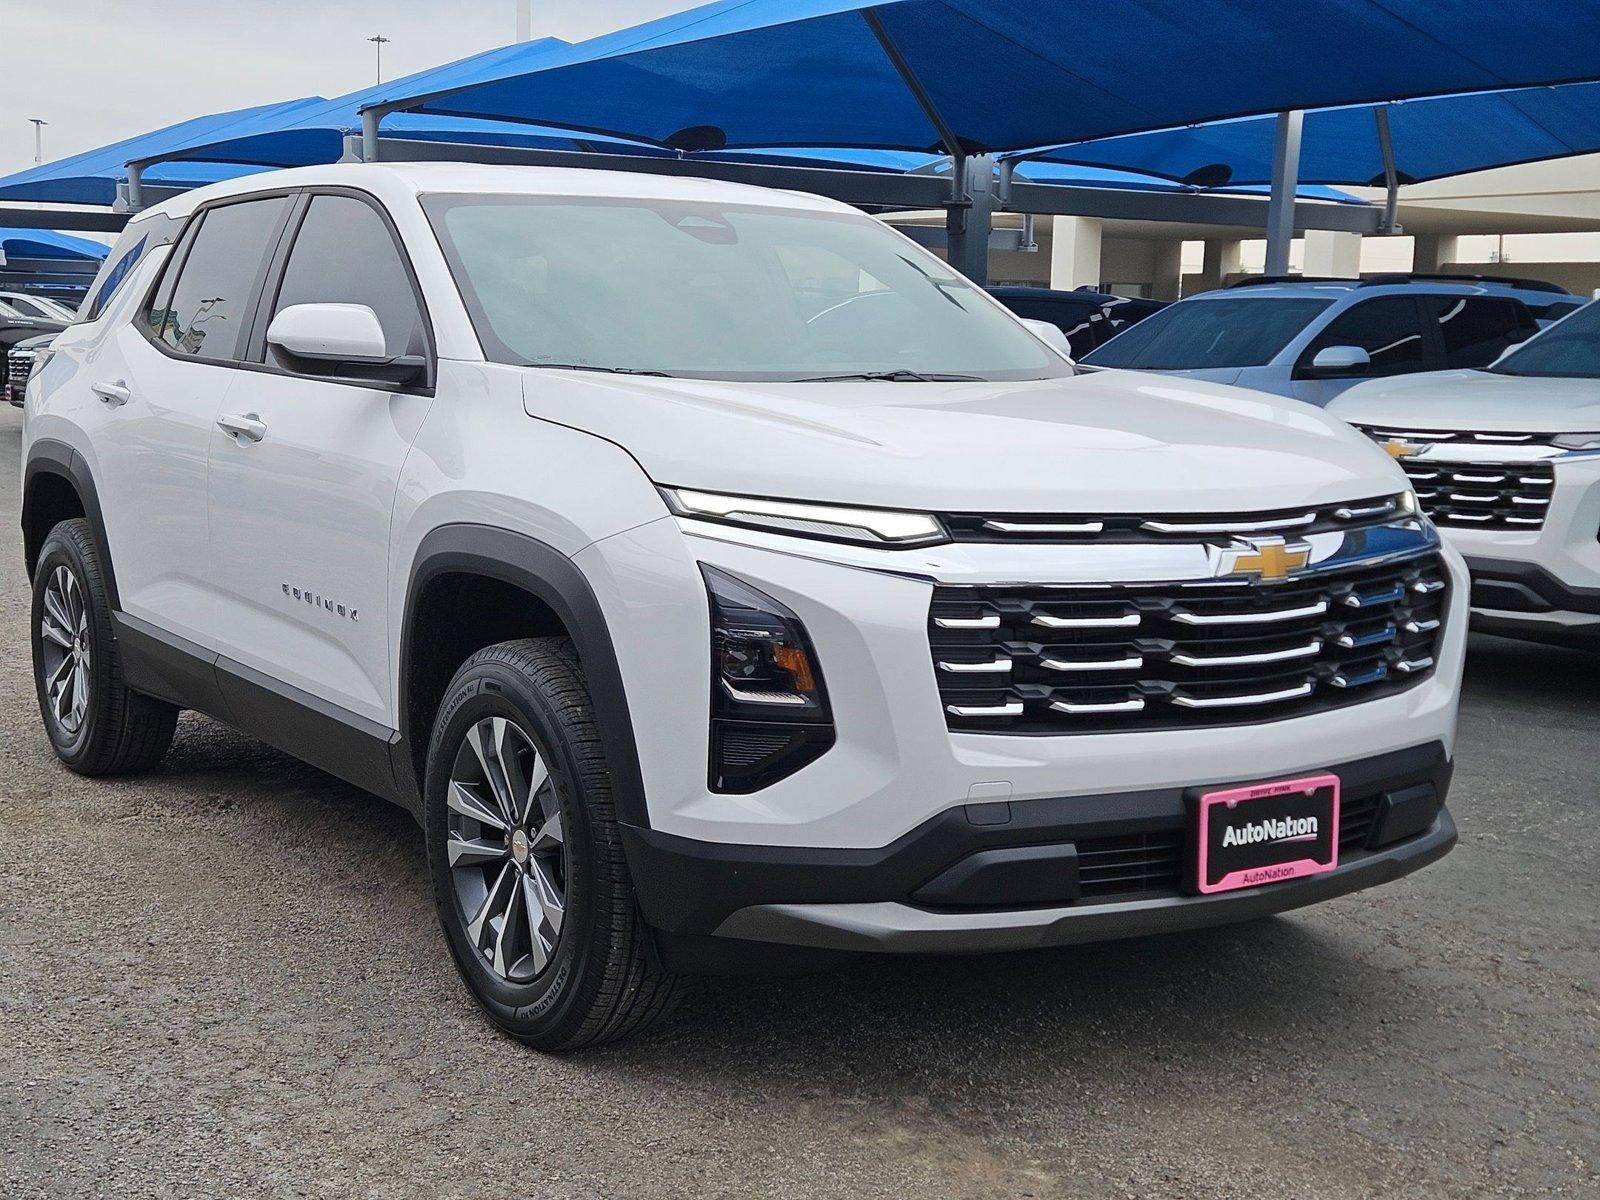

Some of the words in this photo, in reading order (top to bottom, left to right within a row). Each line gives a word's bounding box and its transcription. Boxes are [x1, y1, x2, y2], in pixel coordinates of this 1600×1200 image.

[281, 582, 359, 622] EQUINOX
[1222, 816, 1318, 847] AutoNation
[1243, 867, 1295, 884] AutoNation
